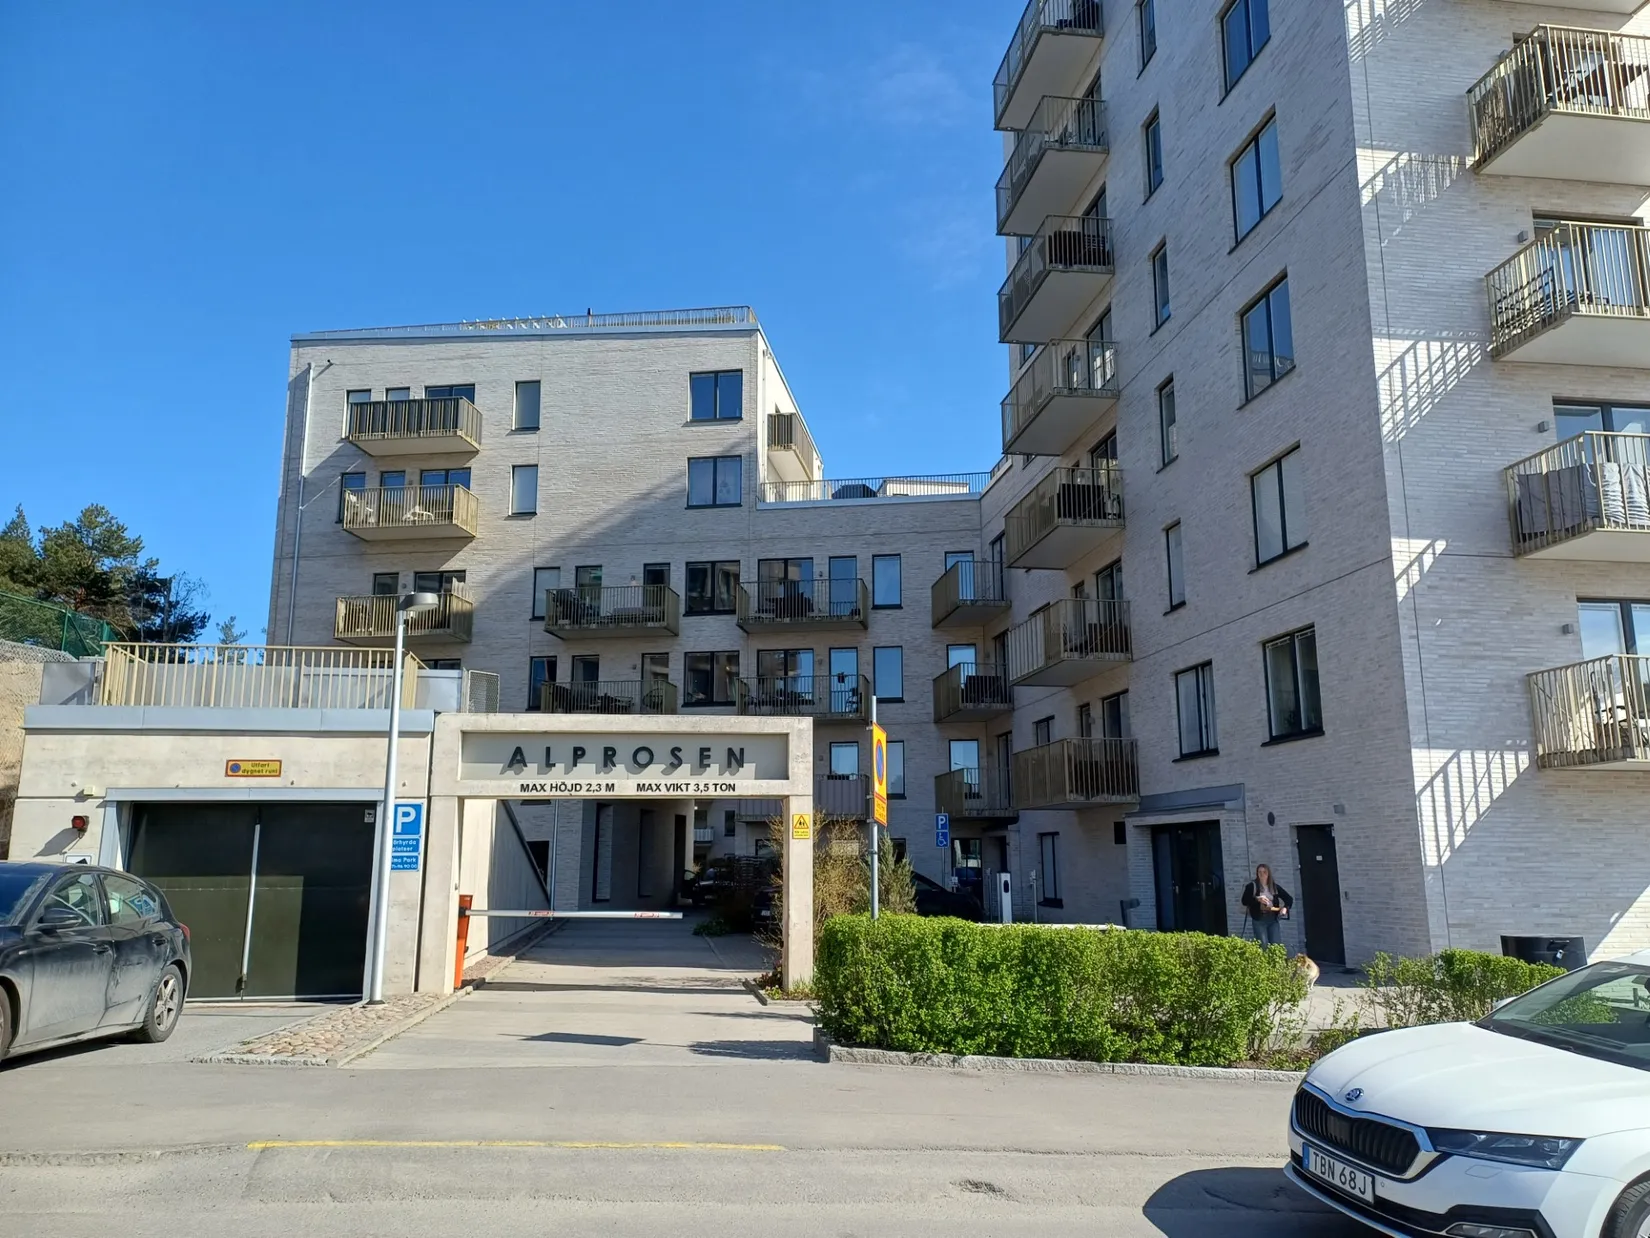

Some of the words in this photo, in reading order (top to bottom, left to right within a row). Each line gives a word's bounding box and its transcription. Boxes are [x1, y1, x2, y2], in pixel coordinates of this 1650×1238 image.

[507, 746, 745, 769] ALPROSEN
[520, 783, 548, 793] MAX
[550, 781, 583, 793] HÖJD
[585, 783, 602, 794] 2,3
[605, 783, 615, 793] M
[636, 783, 665, 793] MAX
[665, 783, 691, 793] VIKT
[693, 783, 710, 794] 3,5
[712, 783, 736, 793] TON
[396, 807, 416, 833] P
[938, 816, 946, 830] P
[1312, 1151, 1336, 1181] TBN
[1339, 1166, 1367, 1196] 68J
